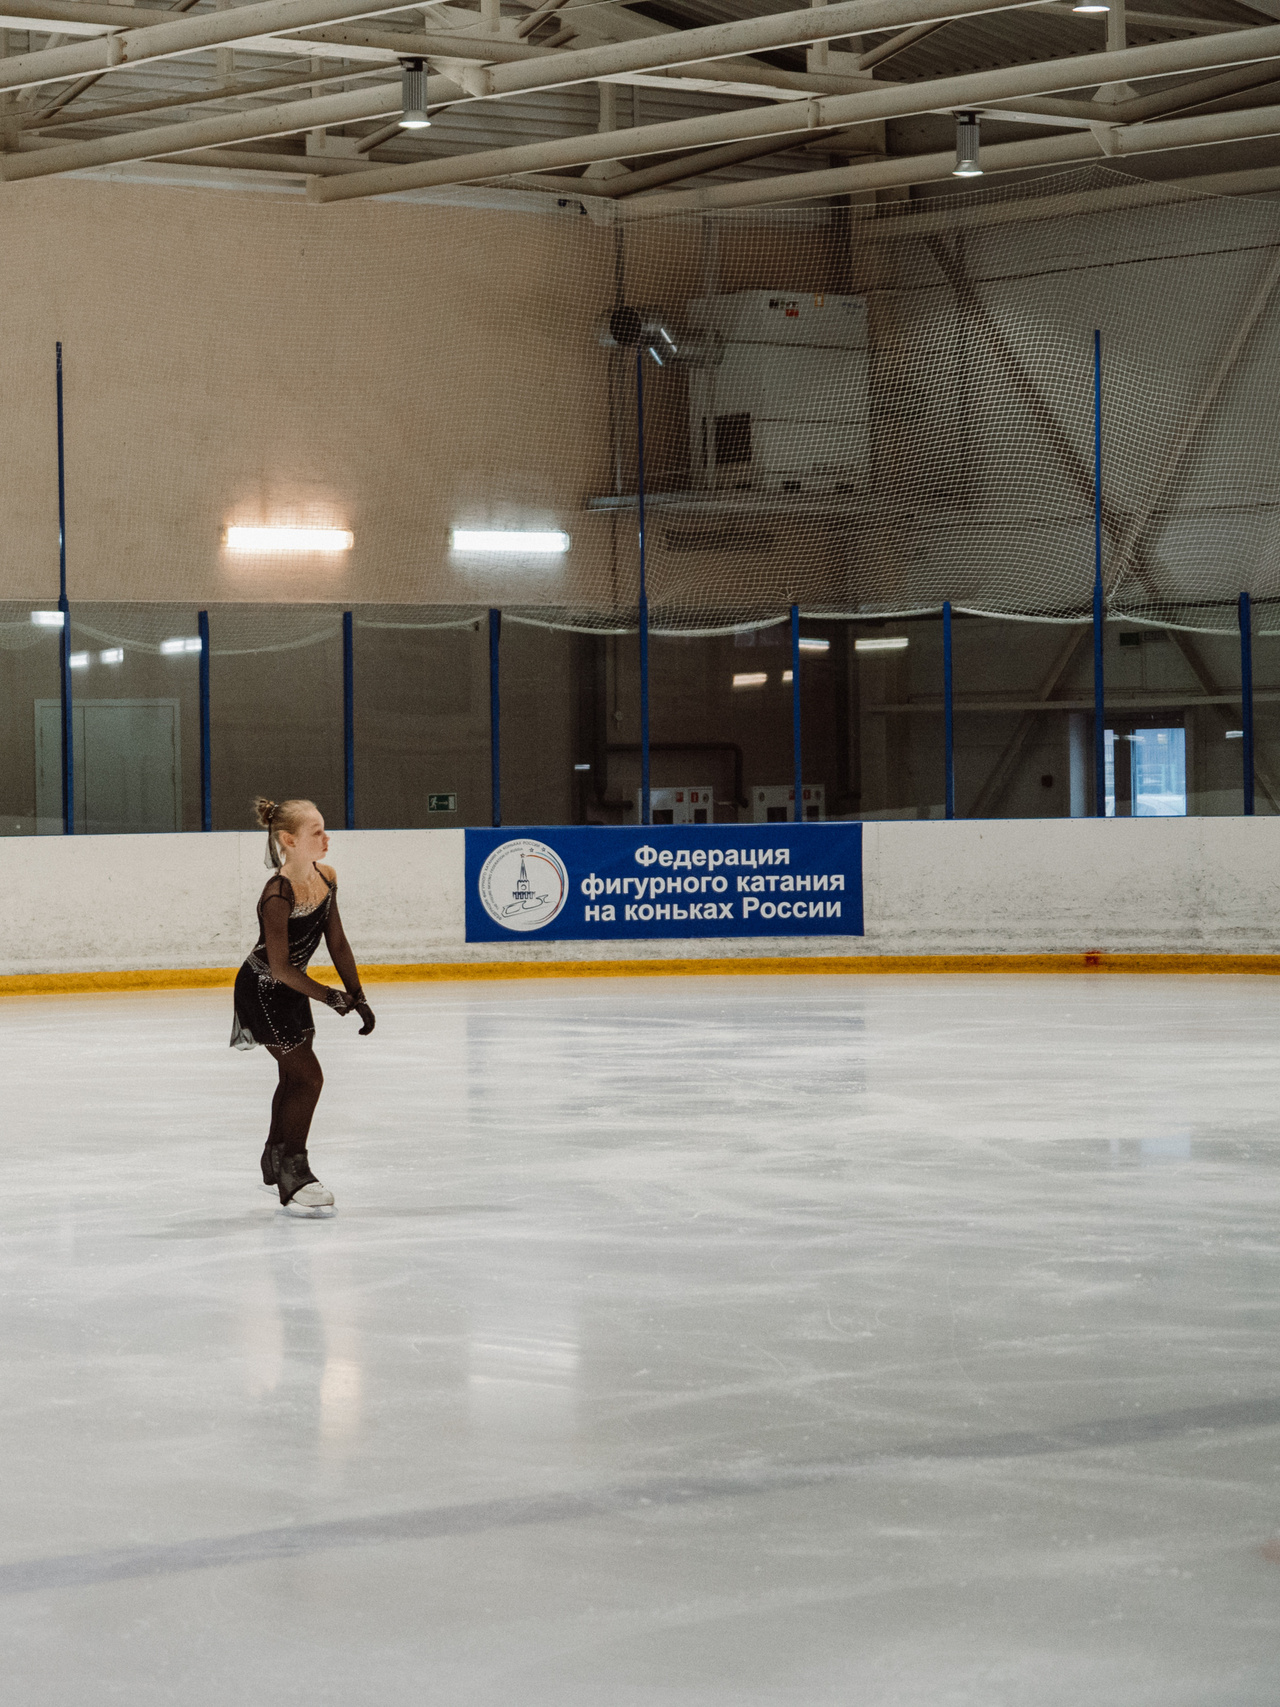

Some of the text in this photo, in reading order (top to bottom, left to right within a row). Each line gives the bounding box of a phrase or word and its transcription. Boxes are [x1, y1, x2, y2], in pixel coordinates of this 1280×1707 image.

[635, 845, 790, 871] Федерация
[581, 873, 845, 900] фигурного катания
[585, 897, 842, 922] на коньках России
